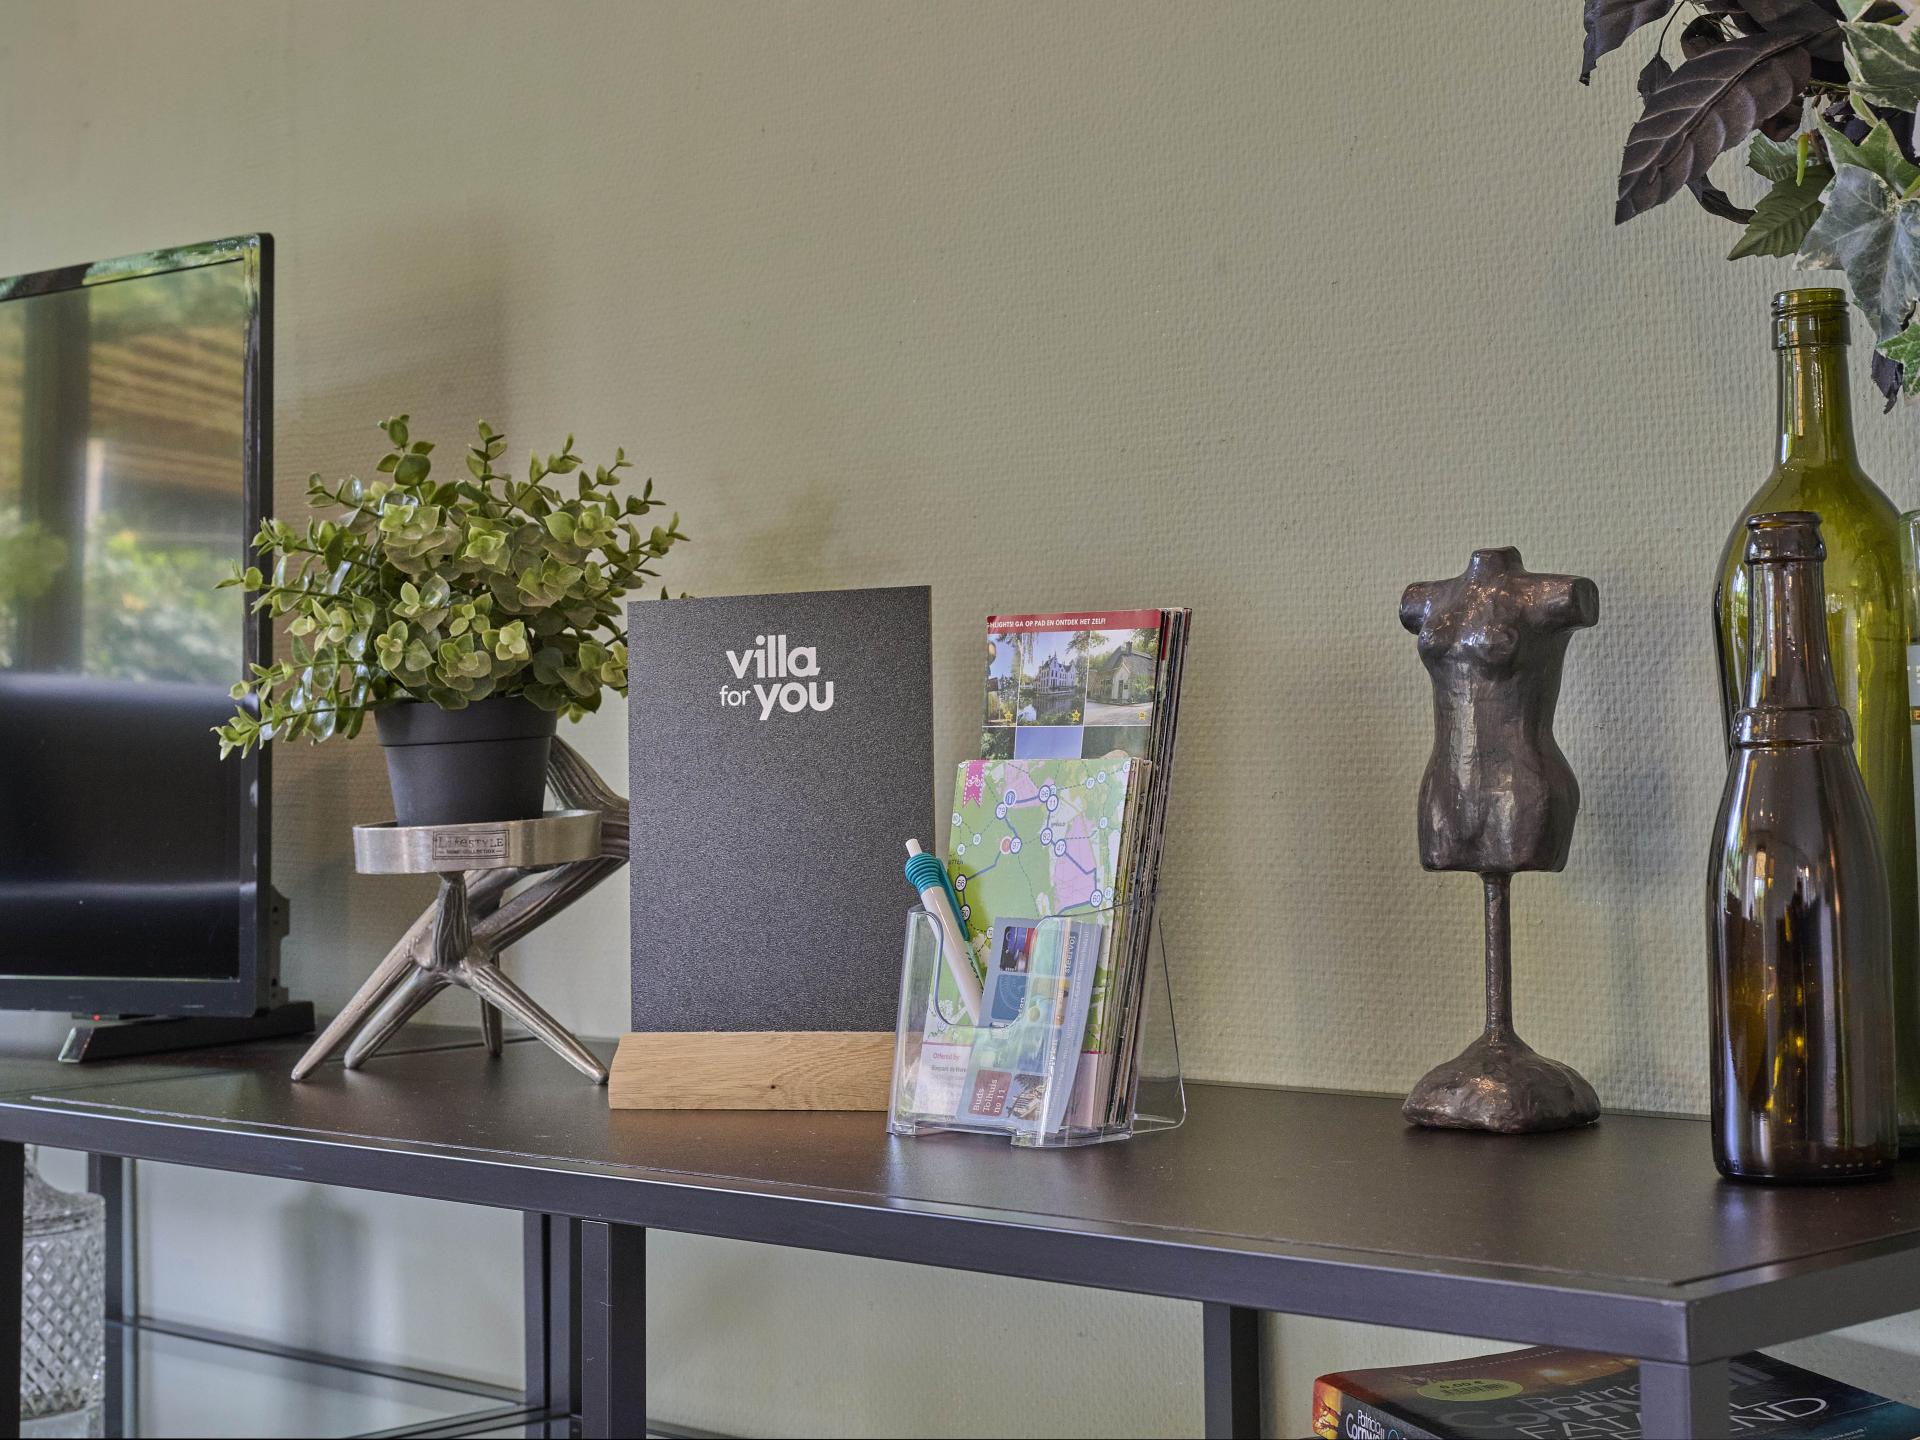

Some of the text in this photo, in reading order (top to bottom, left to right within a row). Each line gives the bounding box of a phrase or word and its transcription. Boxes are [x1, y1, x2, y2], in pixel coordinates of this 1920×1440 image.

[725, 634, 821, 679] villa
[719, 681, 834, 721] for you
[973, 1088, 984, 1111] Buds
[982, 1079, 998, 1112] Tolhuis
[1357, 1409, 1381, 1435] Patricia
